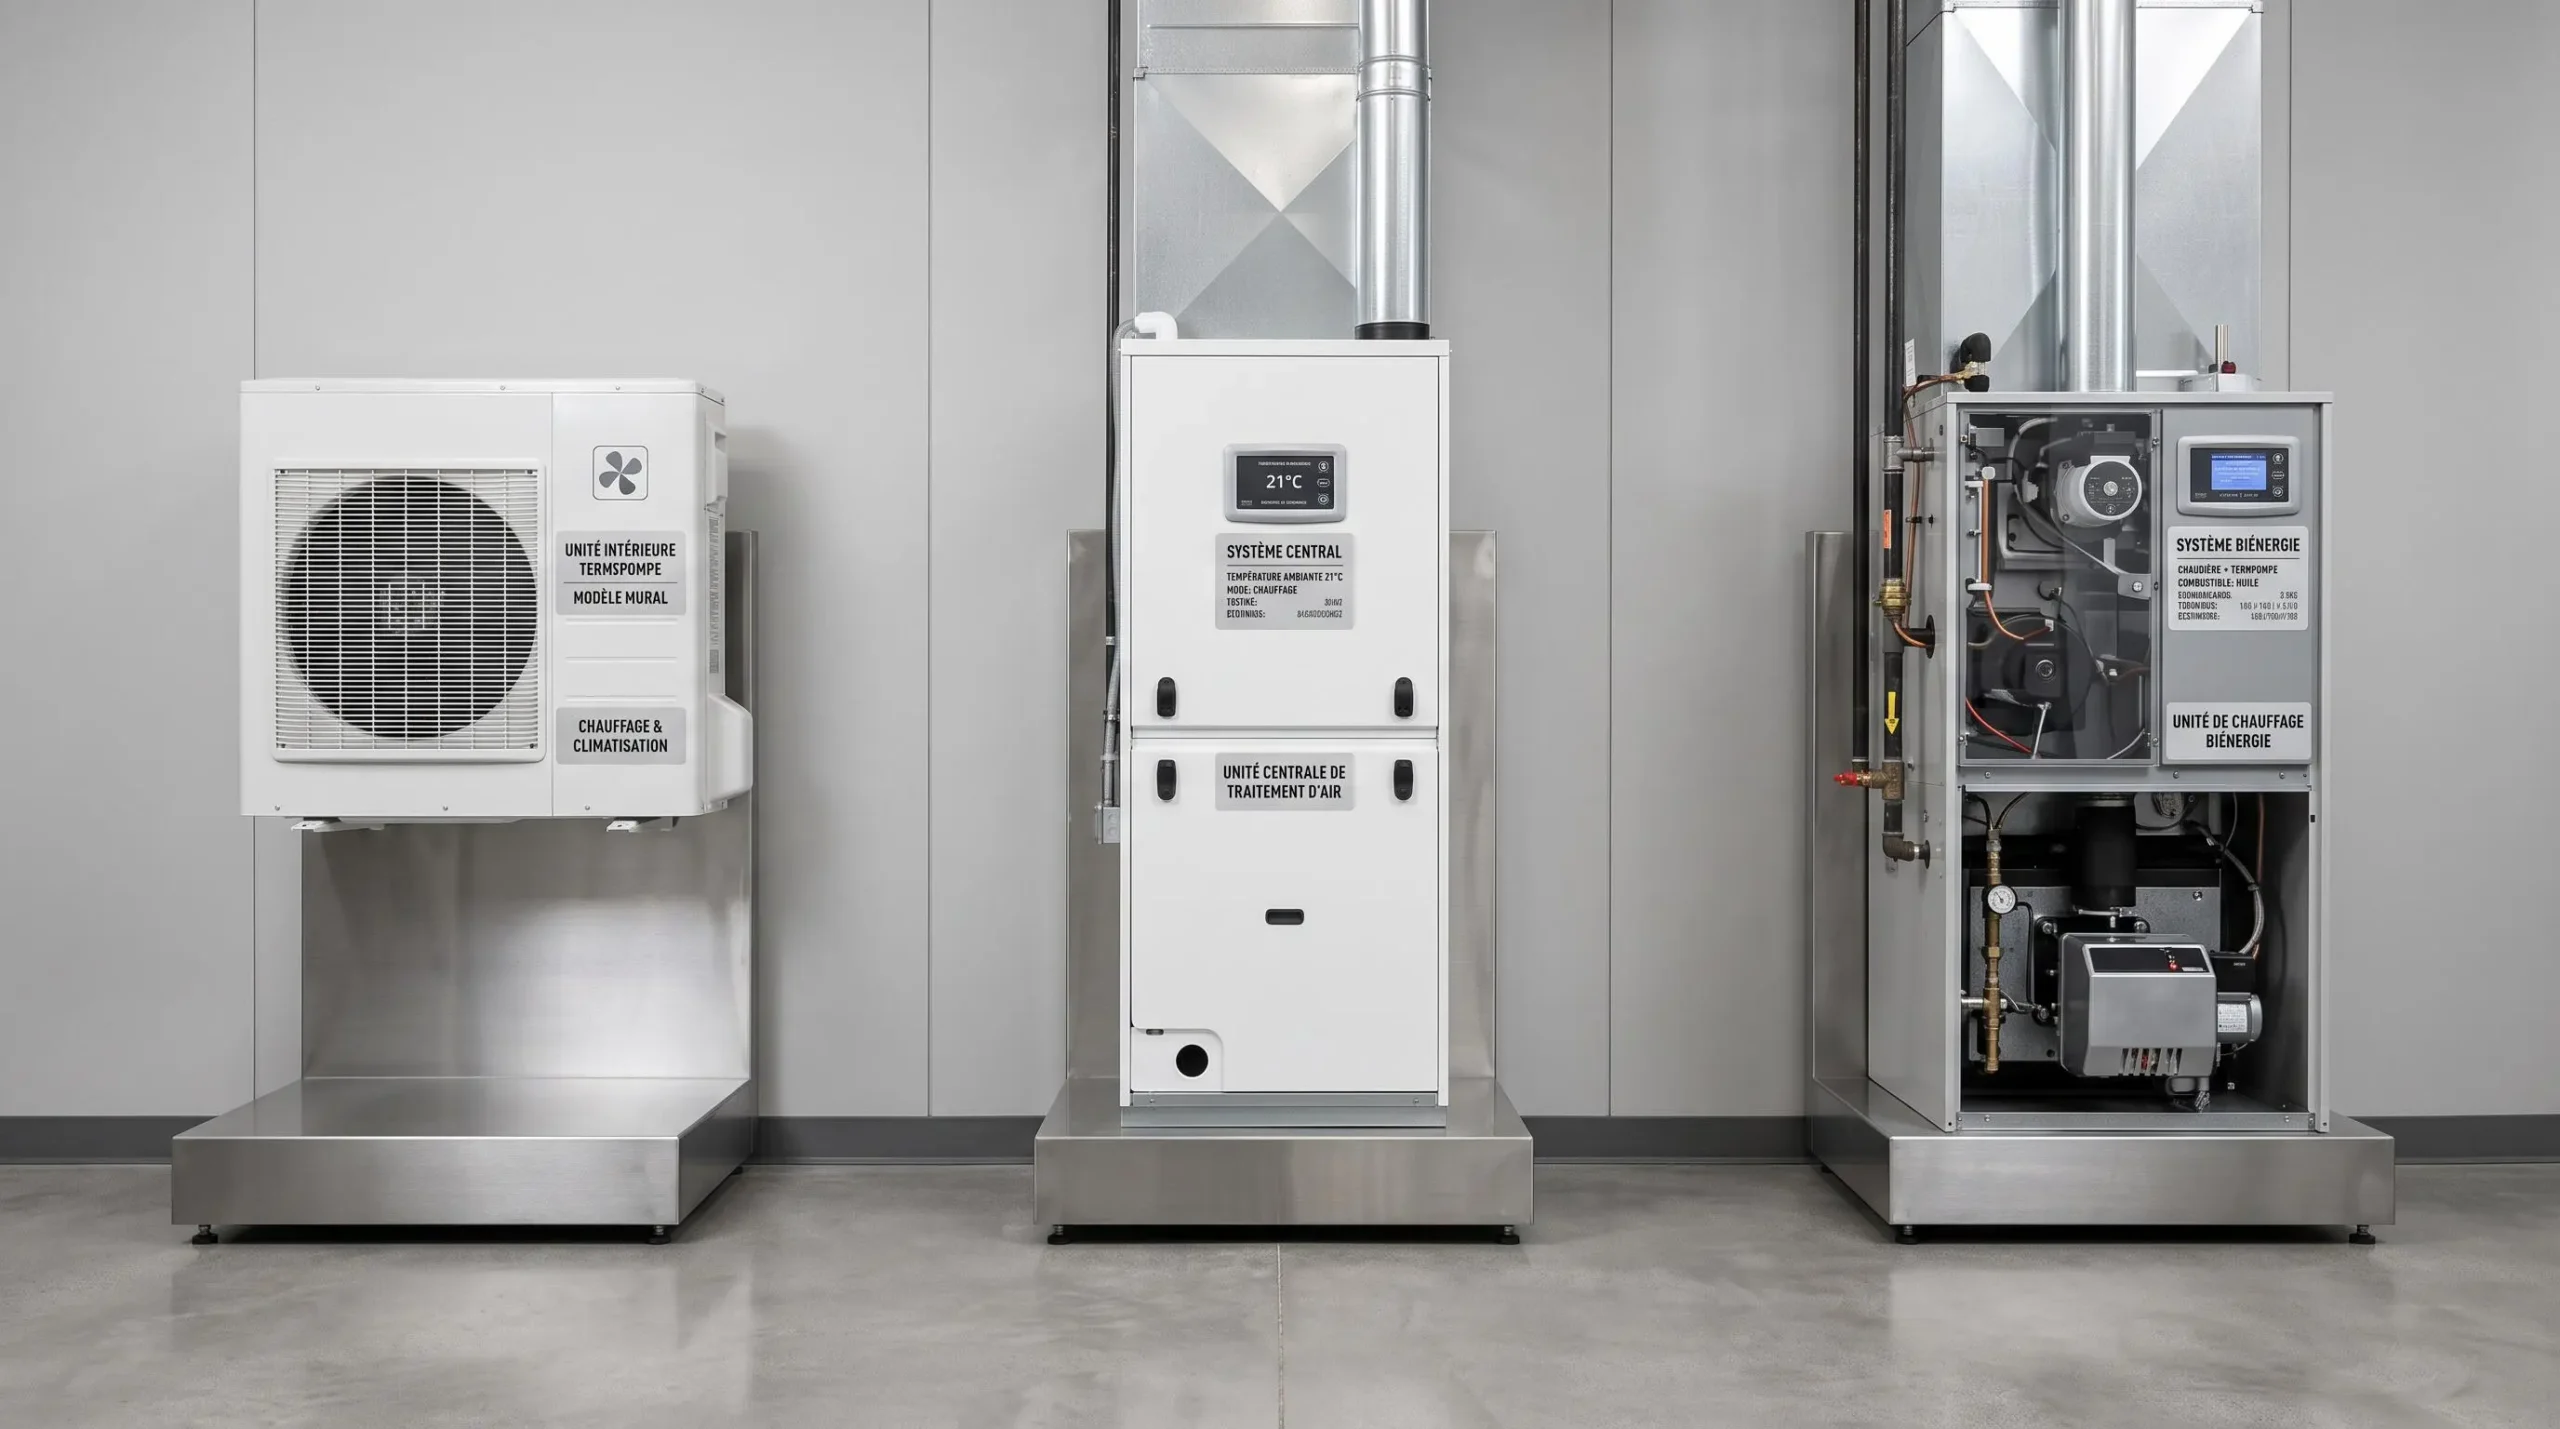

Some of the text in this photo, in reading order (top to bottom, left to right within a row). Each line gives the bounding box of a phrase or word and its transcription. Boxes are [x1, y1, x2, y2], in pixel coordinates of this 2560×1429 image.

[1266, 474, 1302, 489] 21°C
[565, 539, 676, 557] UNITÉ INTÉRIEURE
[1227, 541, 1342, 559] SYSTÈME CENTRAL
[2176, 535, 2300, 552] SYSTÈME BIÉNERGIE
[579, 562, 662, 576] TERMSPOMPE
[2178, 563, 2221, 574] CHAUDIÈRE
[1283, 572, 1323, 582] AMBIANTE
[2178, 578, 2259, 588] COMBUSTIBLE: HUILE
[573, 587, 668, 605] MODÈLE MURAL
[1253, 585, 1298, 595] CHAUFFAGE
[578, 719, 663, 733] CHAUFFAGE &
[2173, 711, 2304, 729] UNITÉ DE CHAUFFAGE
[573, 738, 668, 753] CLIMATISATION
[2206, 731, 2272, 748] BIÉNERGIE
[1223, 762, 1346, 780] UNITÉ CENTRALE DE
[1227, 784, 1342, 799] TRAITEMENT D'AIR
